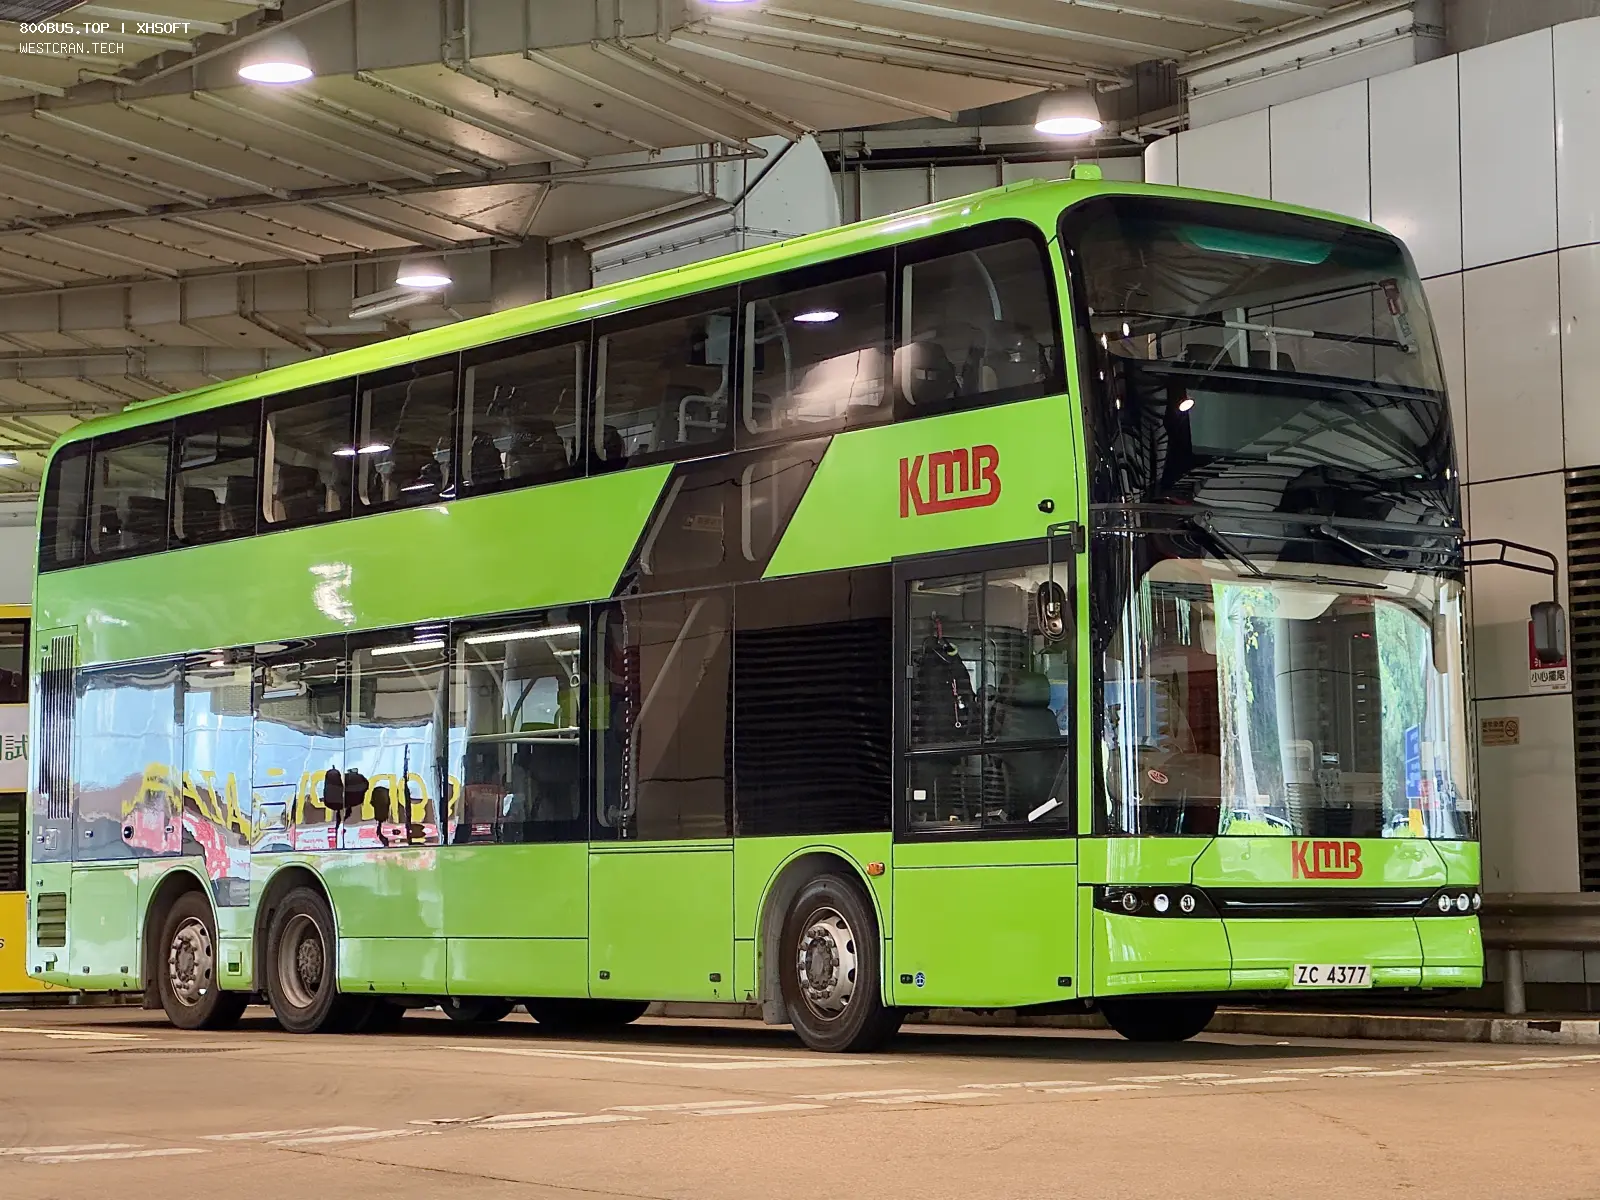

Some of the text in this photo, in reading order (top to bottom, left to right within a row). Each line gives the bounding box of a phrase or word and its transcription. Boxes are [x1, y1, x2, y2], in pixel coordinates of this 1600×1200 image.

[899, 444, 1002, 518] KMB
[0, 734, 28, 761] 試
[1291, 841, 1364, 880] KMB
[1298, 966, 1367, 984] ZC 4377
